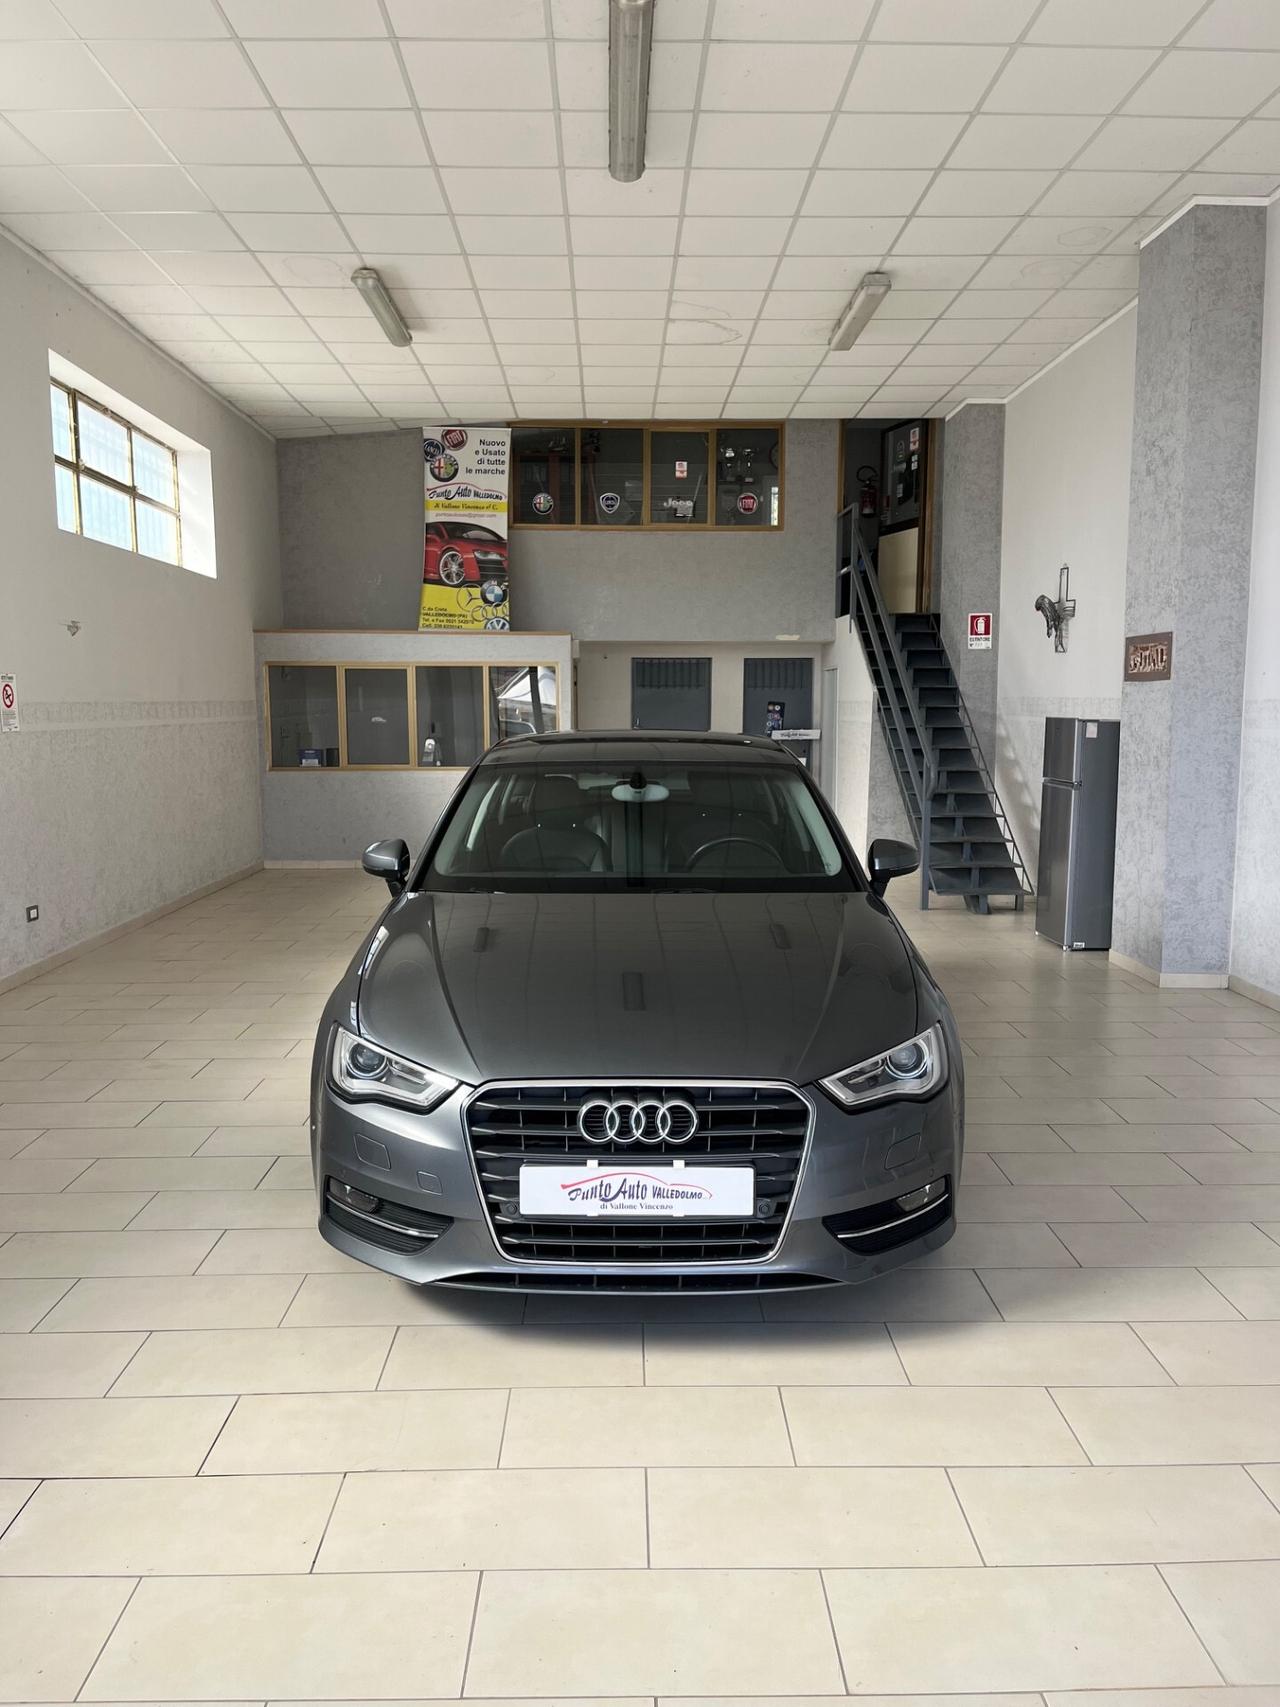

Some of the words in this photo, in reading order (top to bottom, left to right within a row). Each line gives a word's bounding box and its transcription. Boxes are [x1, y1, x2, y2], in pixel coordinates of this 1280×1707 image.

[479, 439, 506, 447] Nuovo
[445, 486, 472, 500] Auto
[473, 490, 503, 501] VALLEDOLMO
[567, 1179, 613, 1202] Punto
[600, 1177, 648, 1203] Auto
[652, 1185, 703, 1200] VALLEDOLMO
